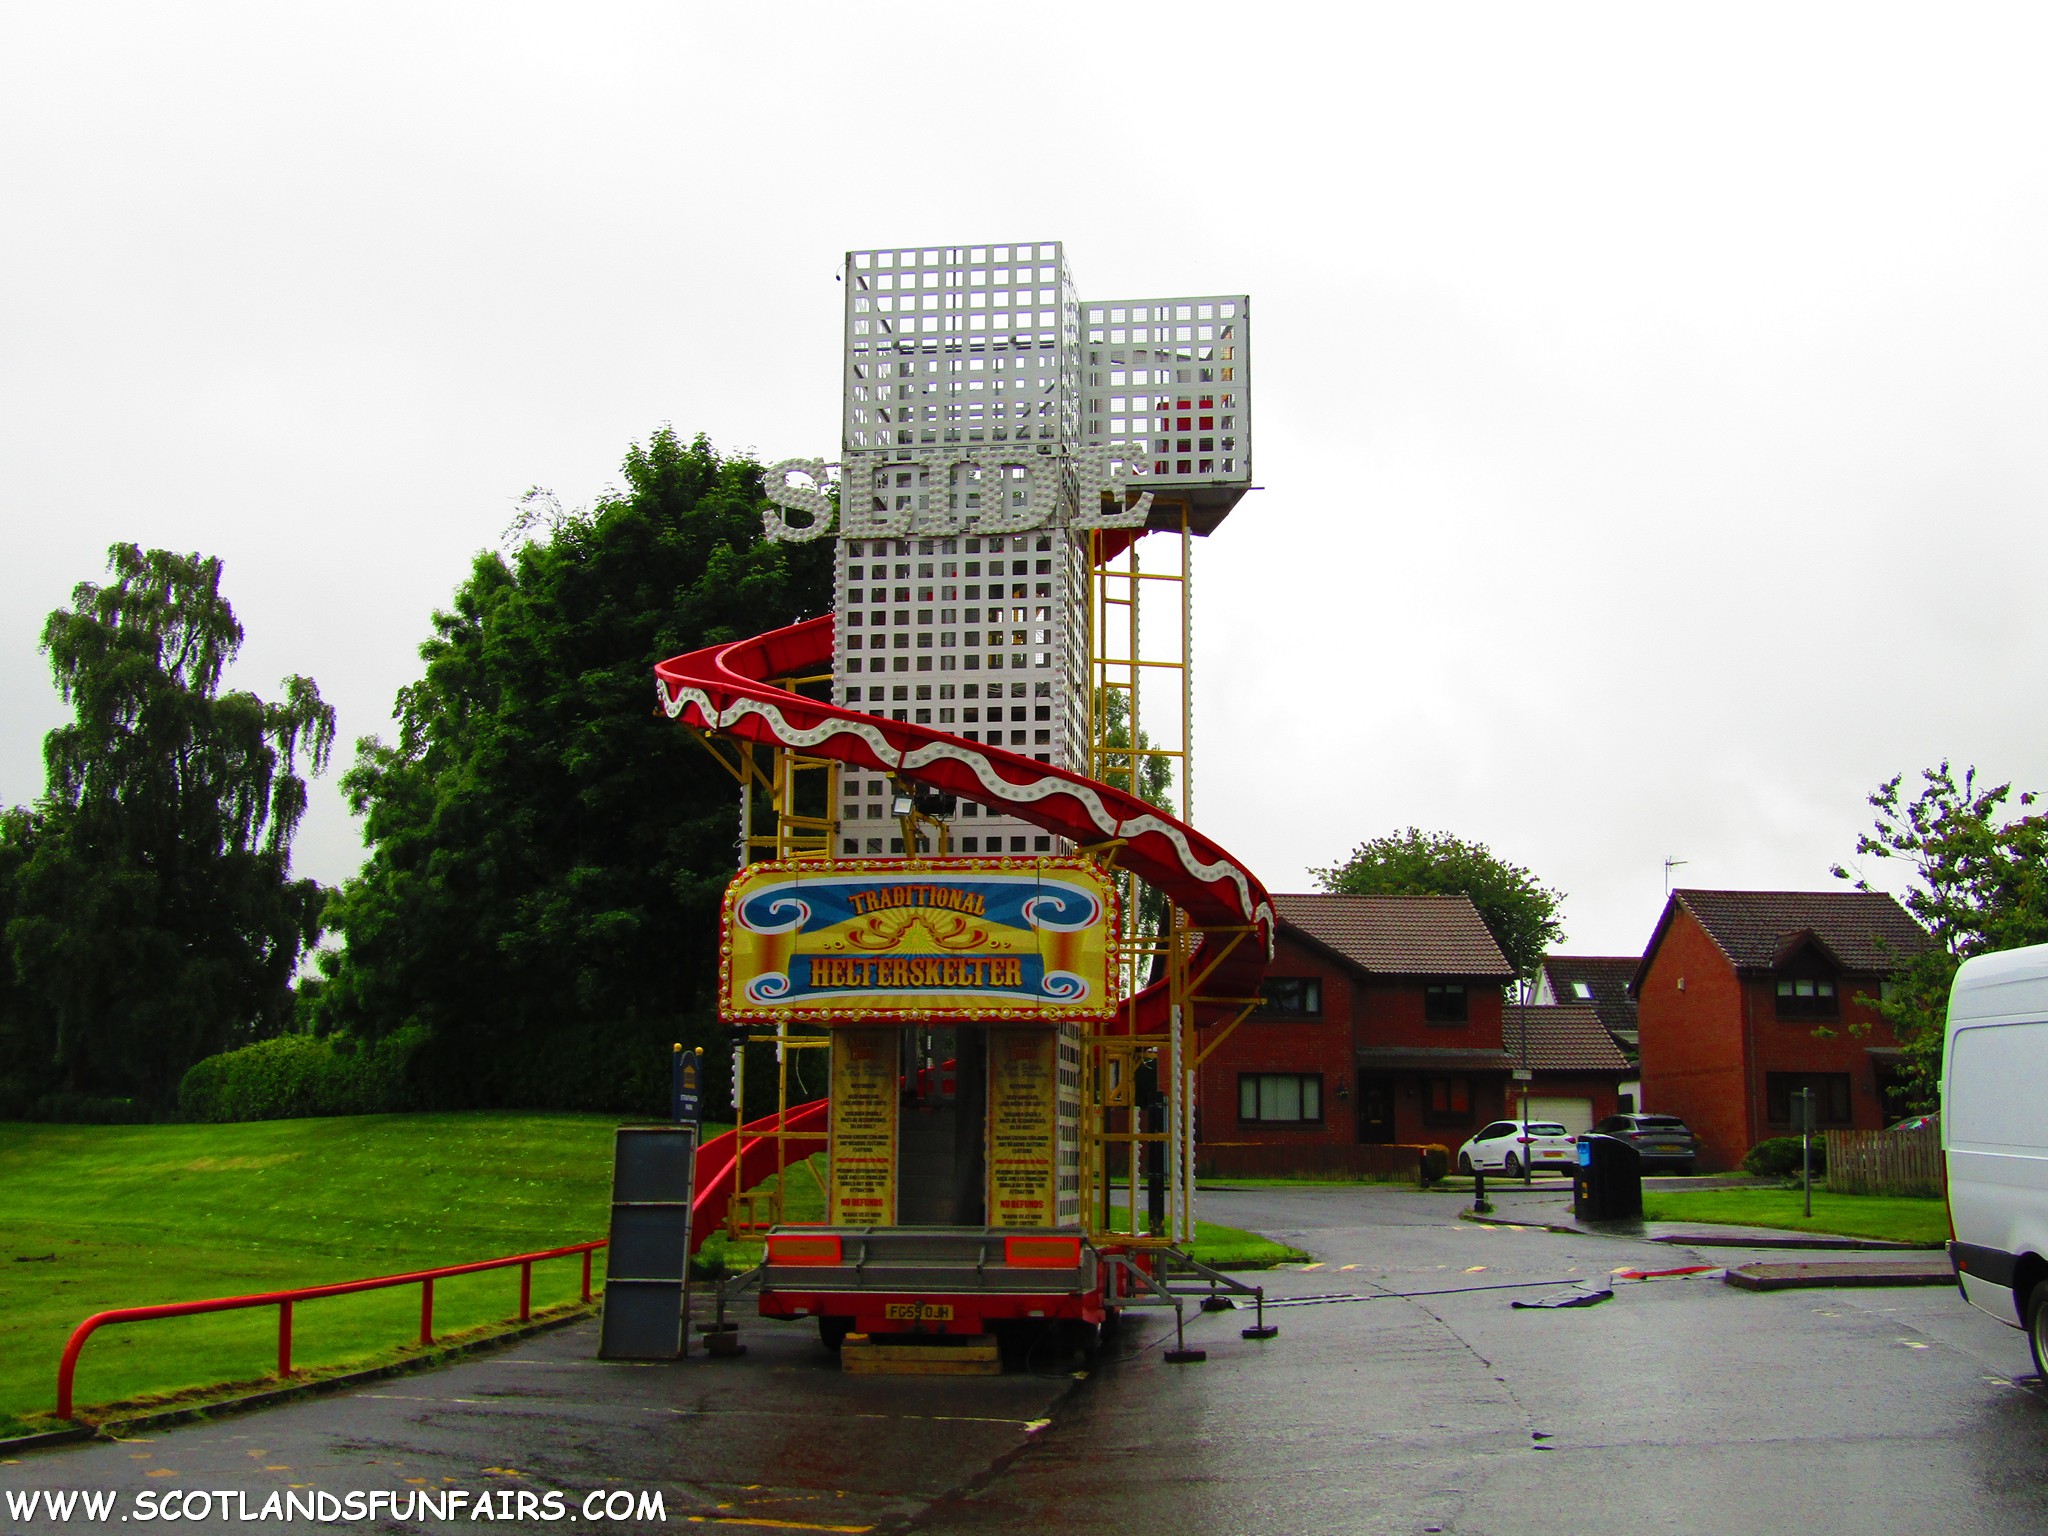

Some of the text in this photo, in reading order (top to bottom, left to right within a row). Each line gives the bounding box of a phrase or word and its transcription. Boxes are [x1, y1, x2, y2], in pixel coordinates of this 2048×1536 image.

[763, 443, 1154, 543] SLIDE
[848, 886, 986, 917] TRADITIONAL
[809, 957, 1023, 989] HELTERSKELTER
[841, 1198, 883, 1206] NO REFUNDS
[1000, 1200, 1043, 1208] NO REFUNDS
